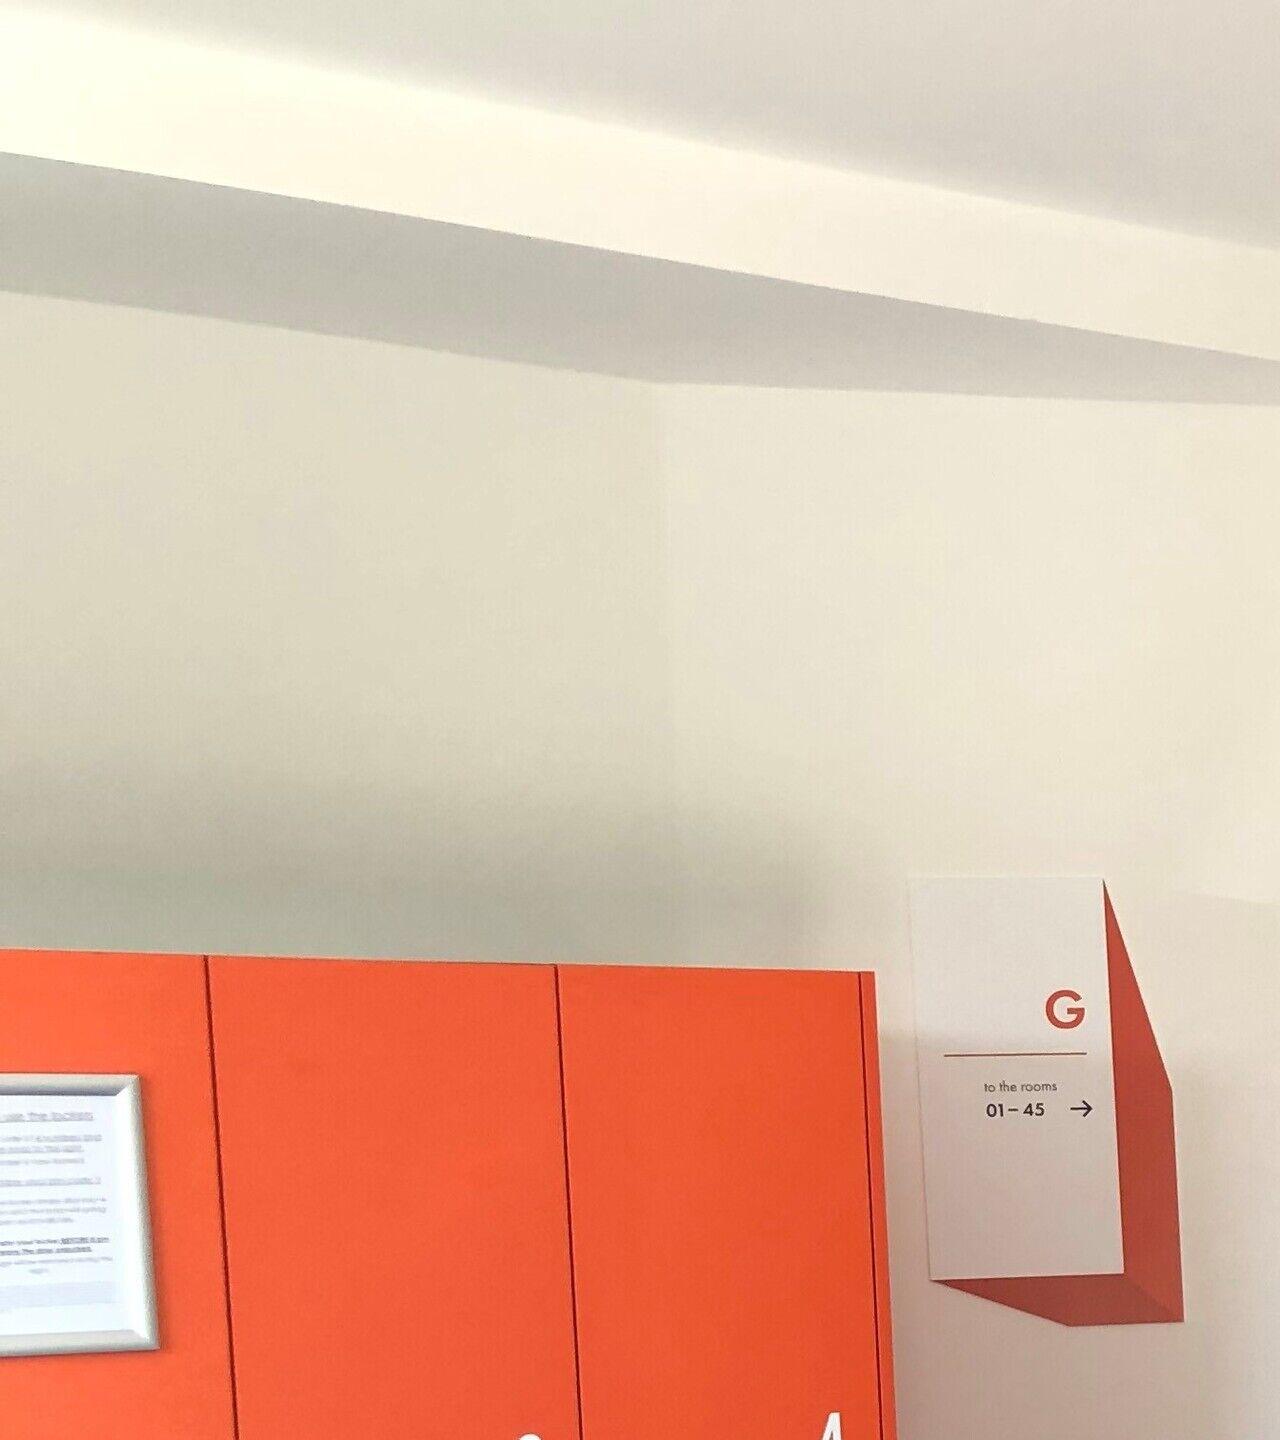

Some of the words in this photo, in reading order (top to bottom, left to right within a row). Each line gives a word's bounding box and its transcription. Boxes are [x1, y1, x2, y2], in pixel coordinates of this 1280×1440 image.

[1045, 989, 1086, 1030] G
[984, 1082, 996, 1093] to
[999, 1080, 1018, 1093] the
[1021, 1081, 1058, 1092] rooms
